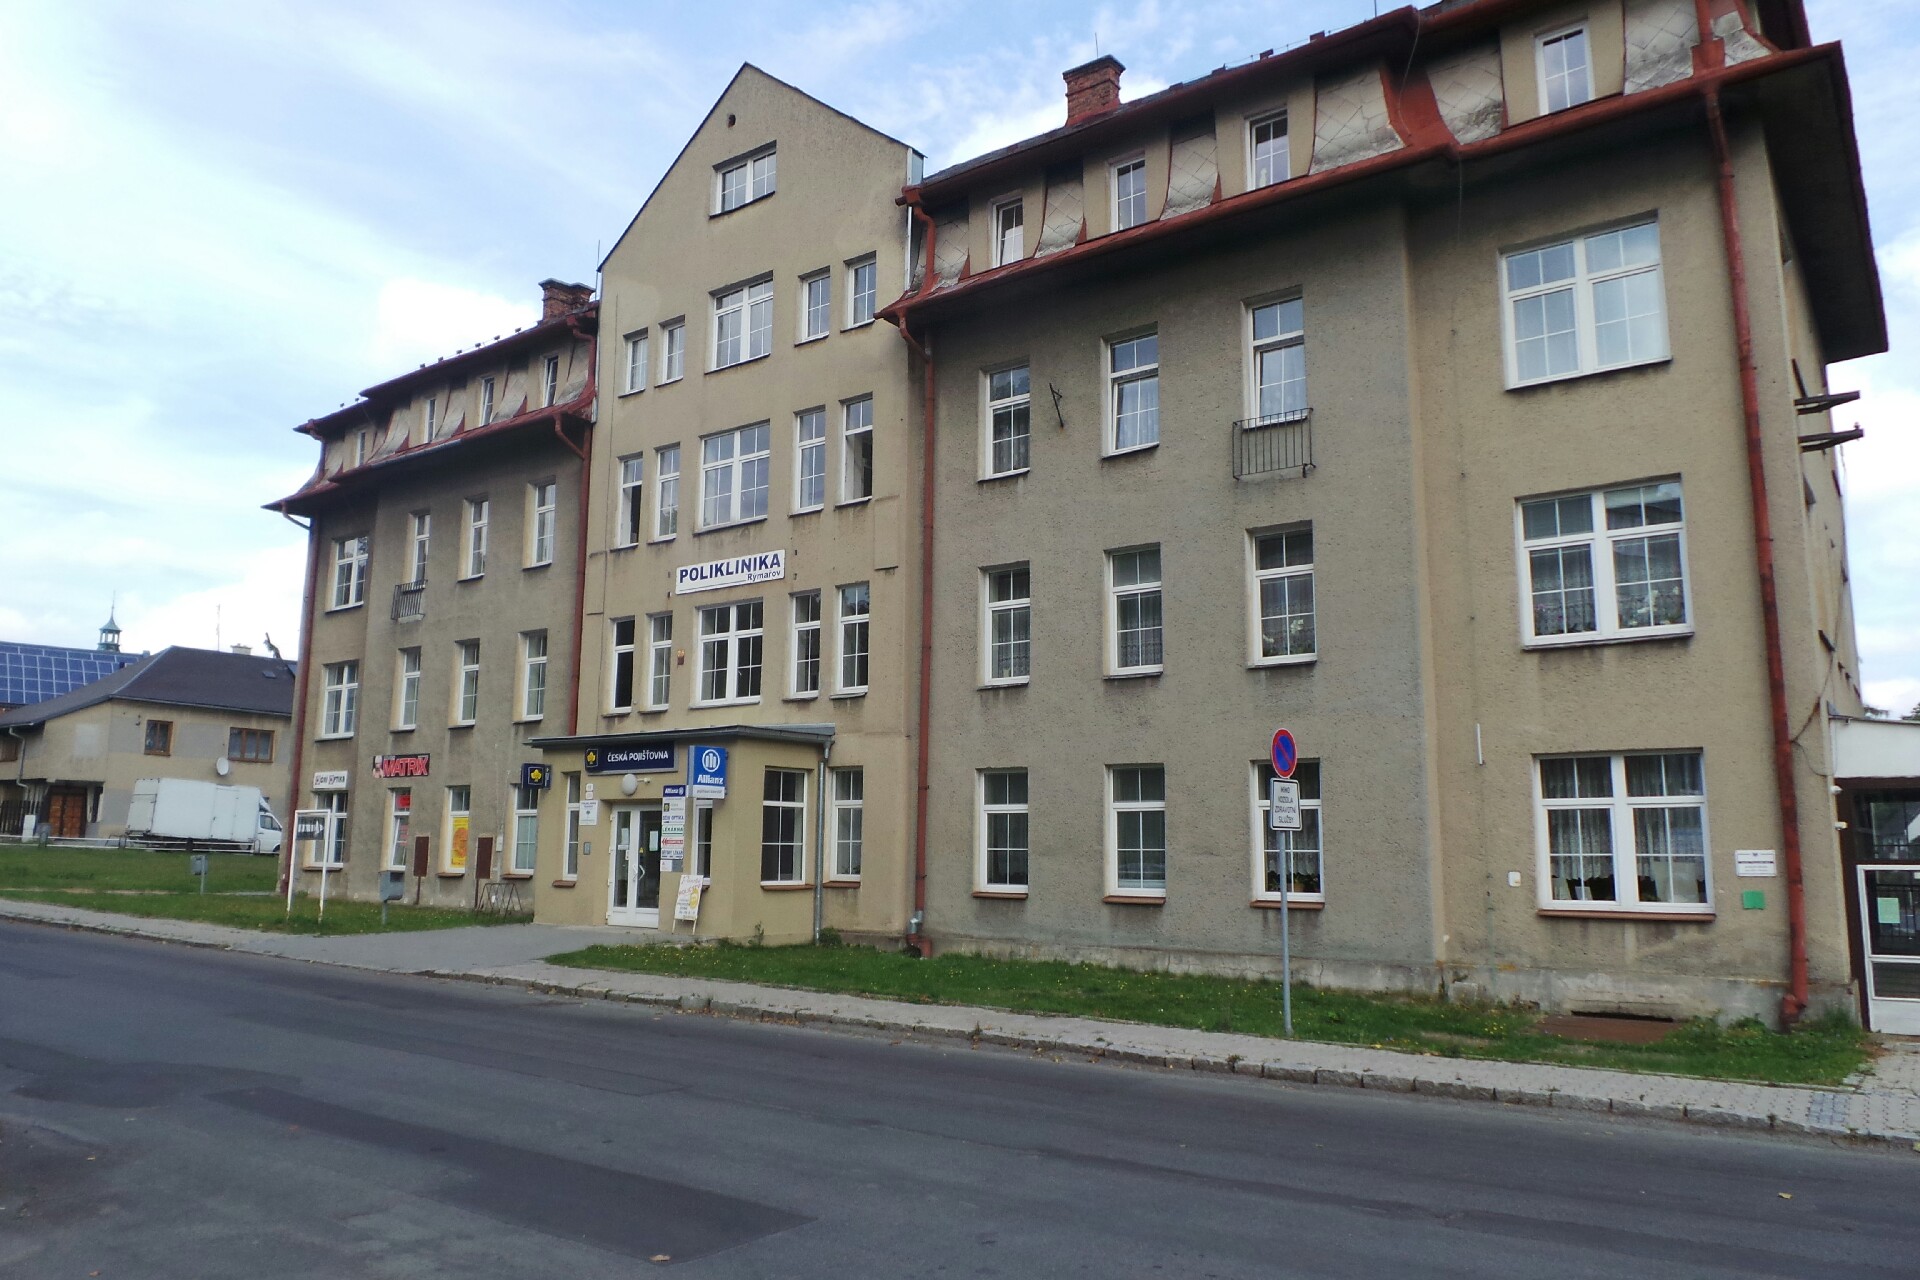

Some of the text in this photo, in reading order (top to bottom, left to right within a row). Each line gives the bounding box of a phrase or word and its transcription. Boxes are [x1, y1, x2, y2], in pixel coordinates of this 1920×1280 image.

[679, 553, 781, 584] POLIKLINIKA
[747, 569, 781, 583] Rýmařov
[607, 749, 669, 762] ČESKÁ POJIŠŤOVNA
[382, 755, 430, 777] MATRIX
[697, 774, 724, 785] Allianz
